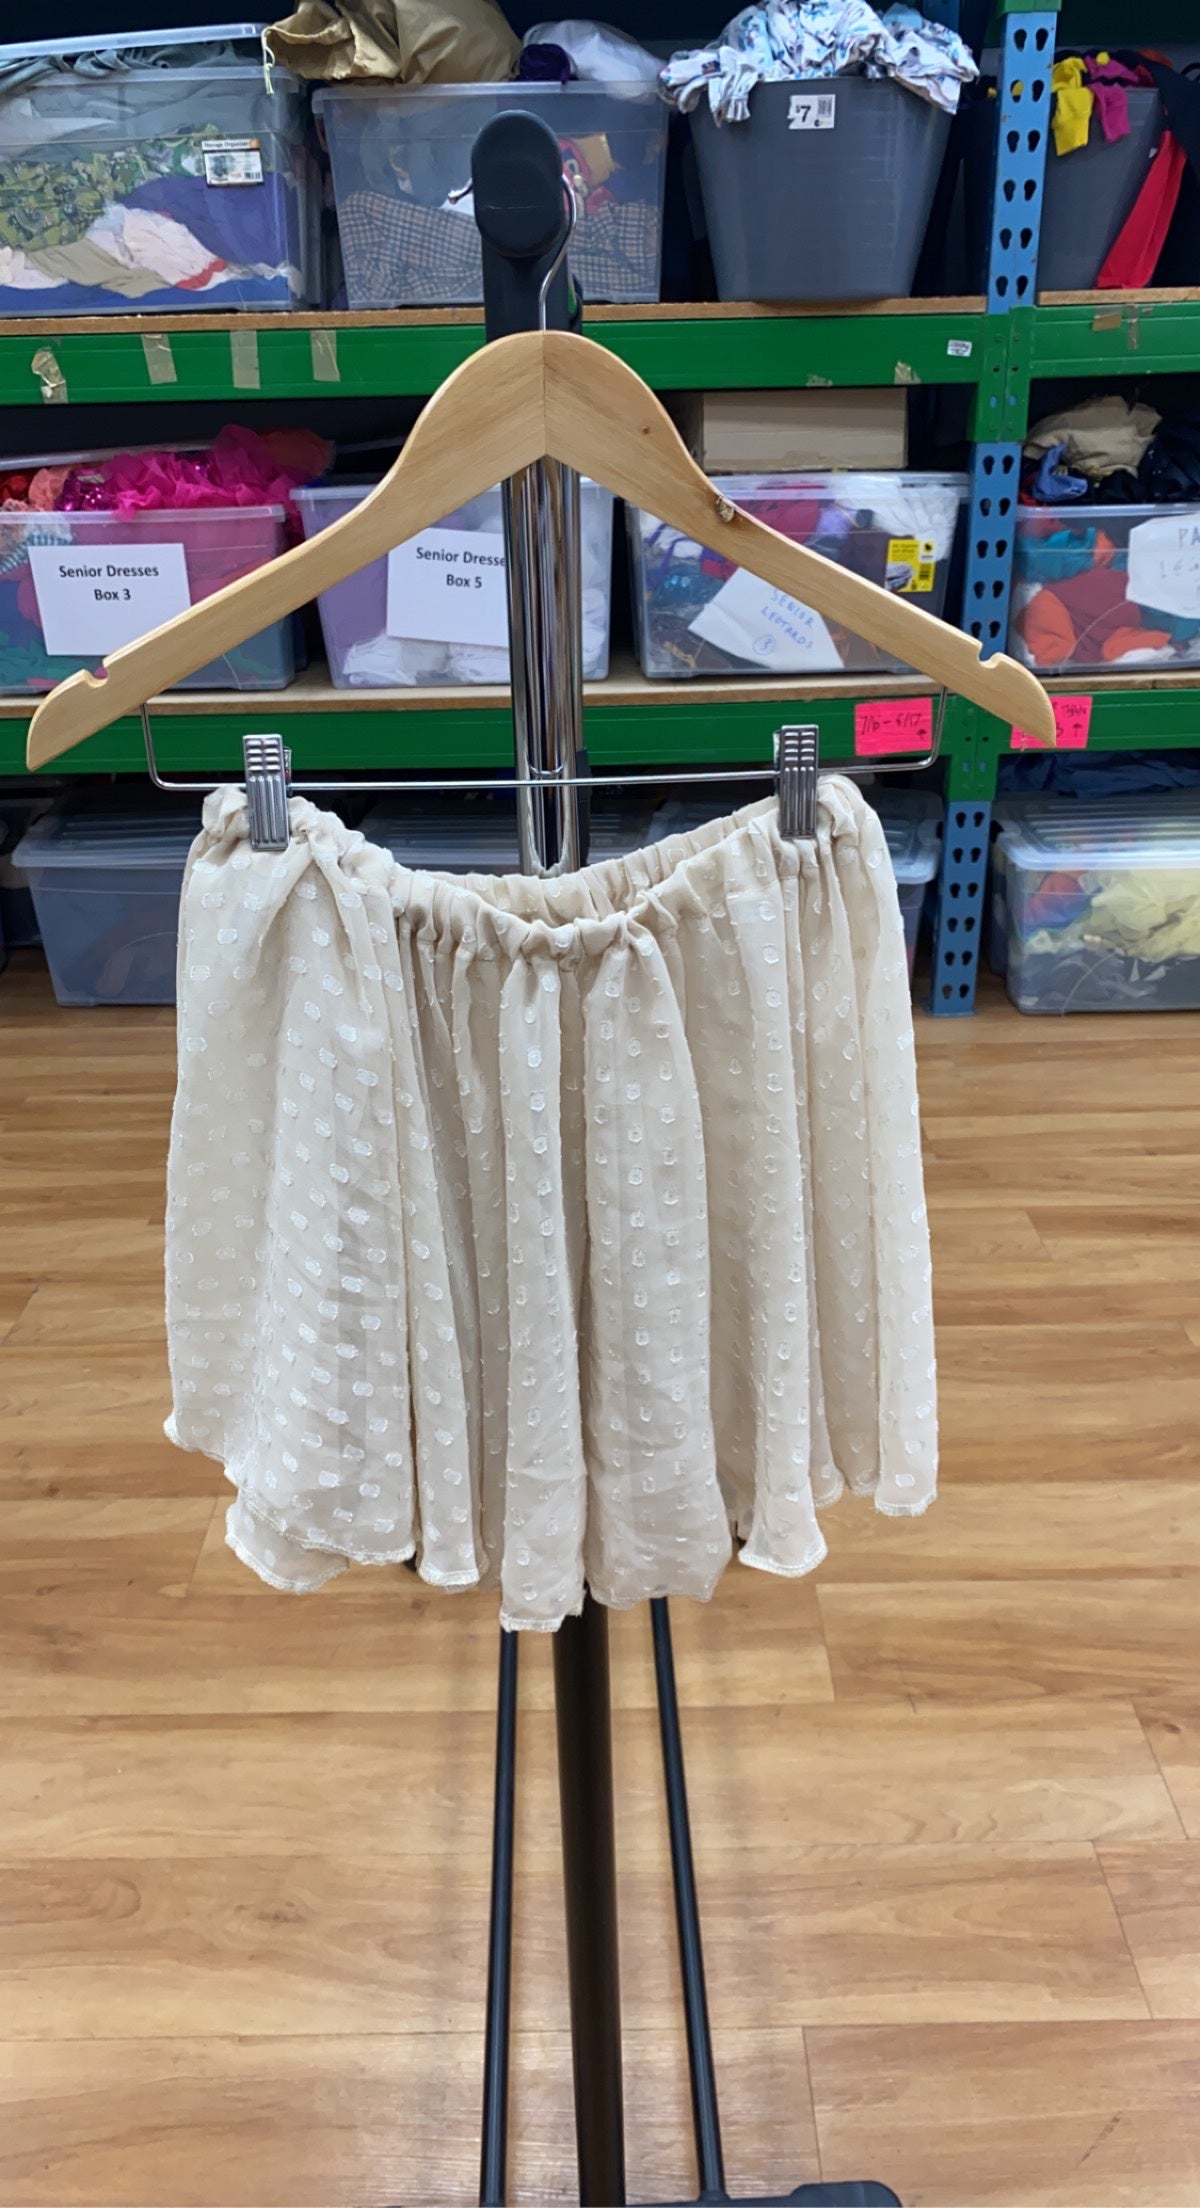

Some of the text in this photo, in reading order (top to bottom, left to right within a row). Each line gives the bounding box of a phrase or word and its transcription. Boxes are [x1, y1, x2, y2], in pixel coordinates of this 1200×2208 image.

[416, 546, 507, 567] Senior Dresse
[59, 564, 159, 578] Senior Dresses
[446, 574, 482, 589] Box 5
[94, 588, 131, 601] Box 3
